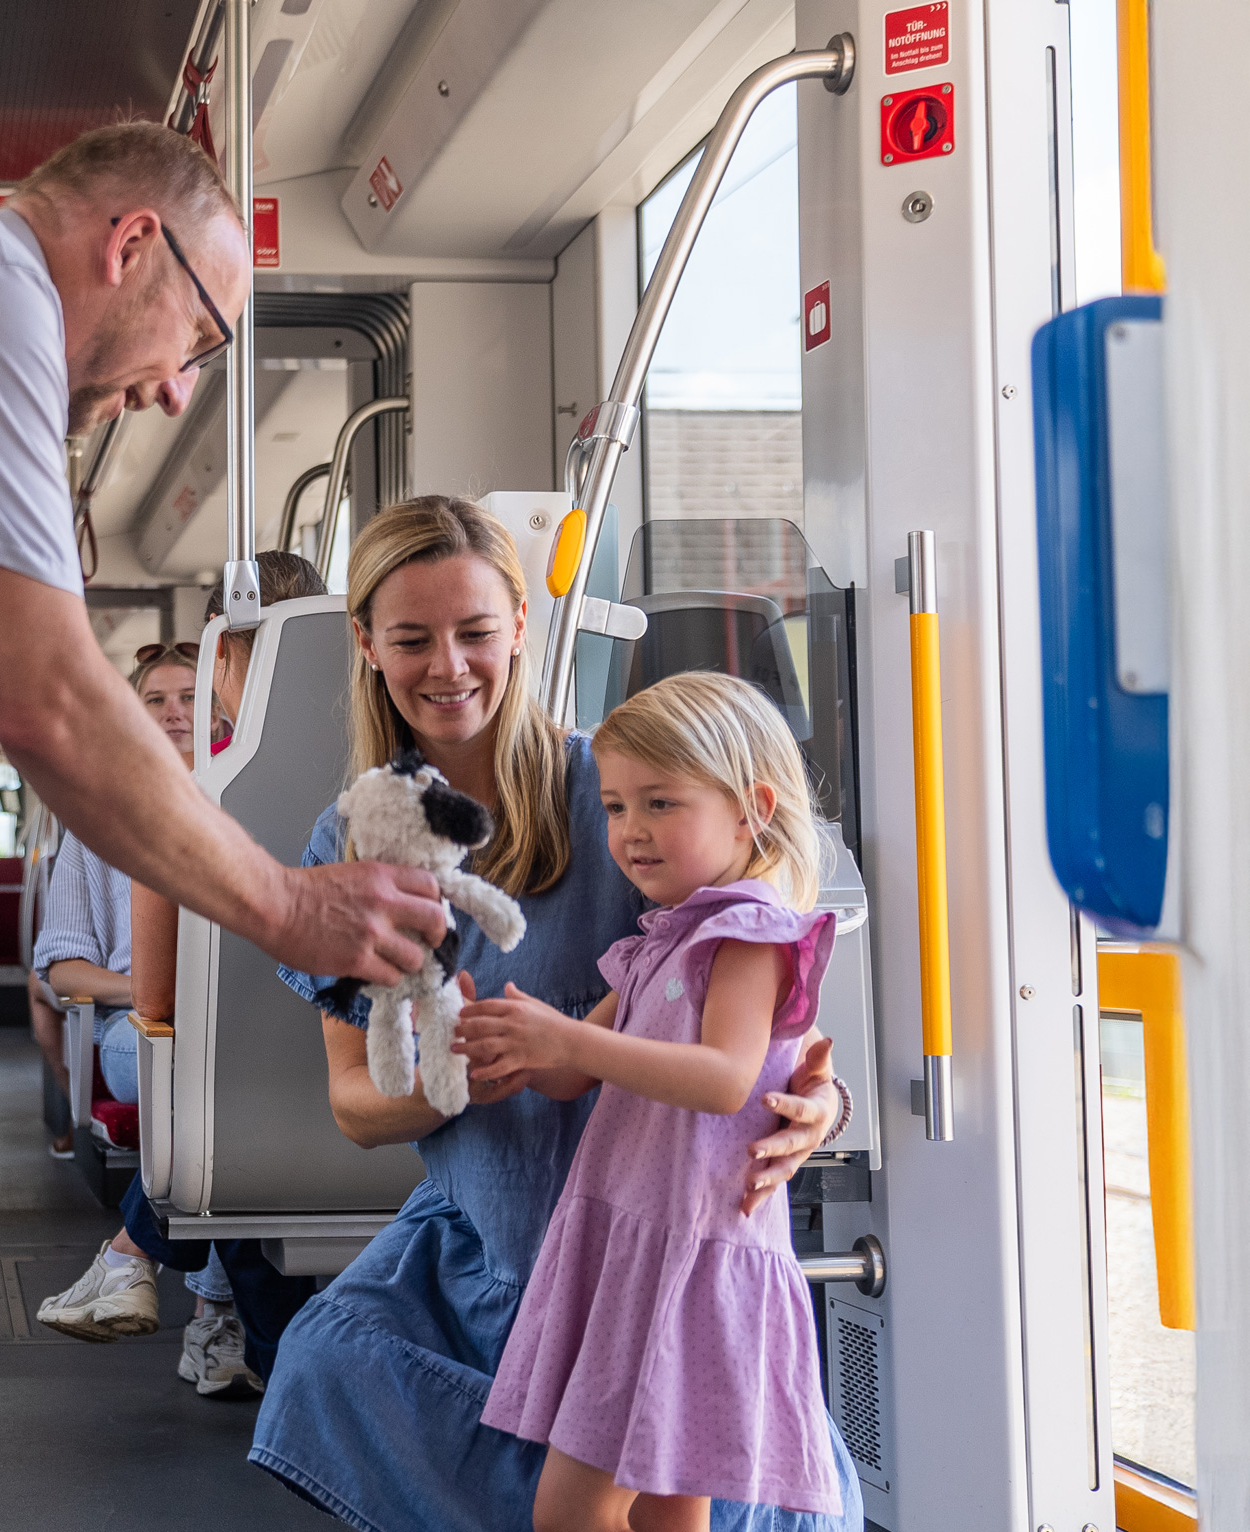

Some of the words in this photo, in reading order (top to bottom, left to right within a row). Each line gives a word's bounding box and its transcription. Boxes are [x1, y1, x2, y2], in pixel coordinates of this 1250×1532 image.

[906, 20, 927, 32] TÜR-
[888, 27, 946, 48] NOTÖFFNUNG
[920, 46, 929, 54] bis
[930, 44, 943, 52] zum
